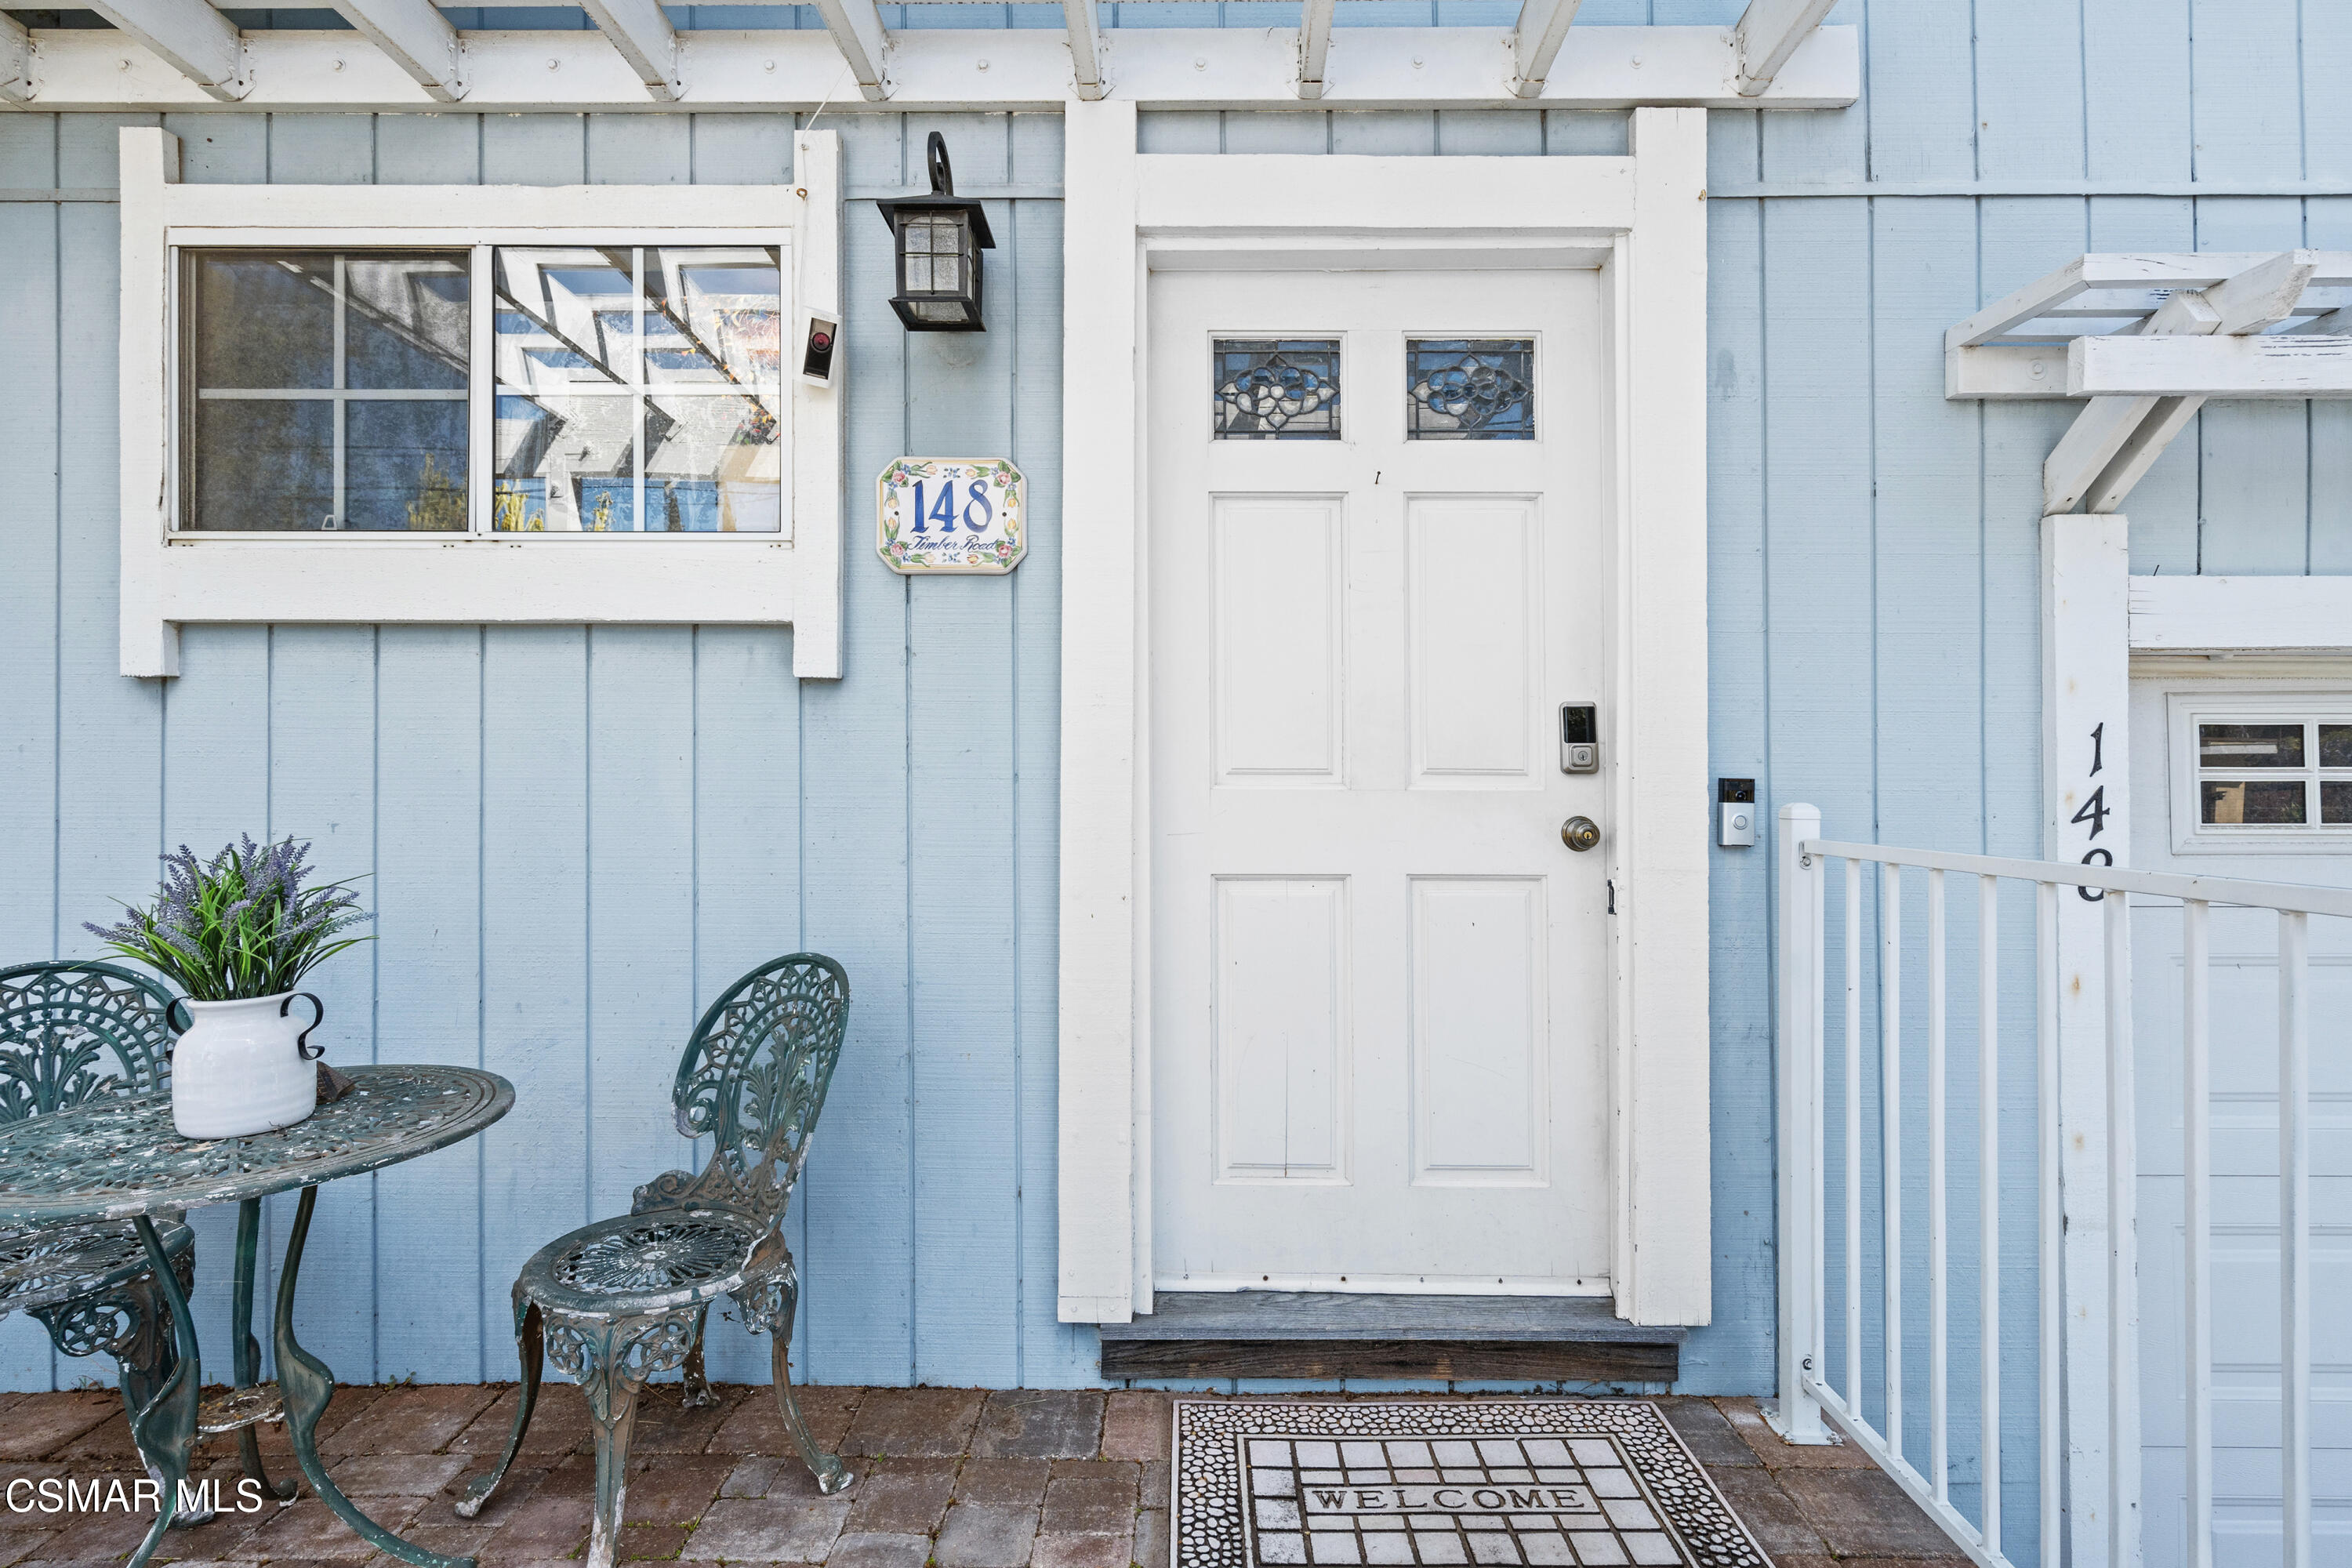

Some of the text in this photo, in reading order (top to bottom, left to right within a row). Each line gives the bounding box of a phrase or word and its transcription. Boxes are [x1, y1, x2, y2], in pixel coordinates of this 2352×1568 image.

[909, 479, 993, 533] 148
[907, 534, 1000, 554] Timber Road
[1312, 1489, 1585, 1510] WELCOME
